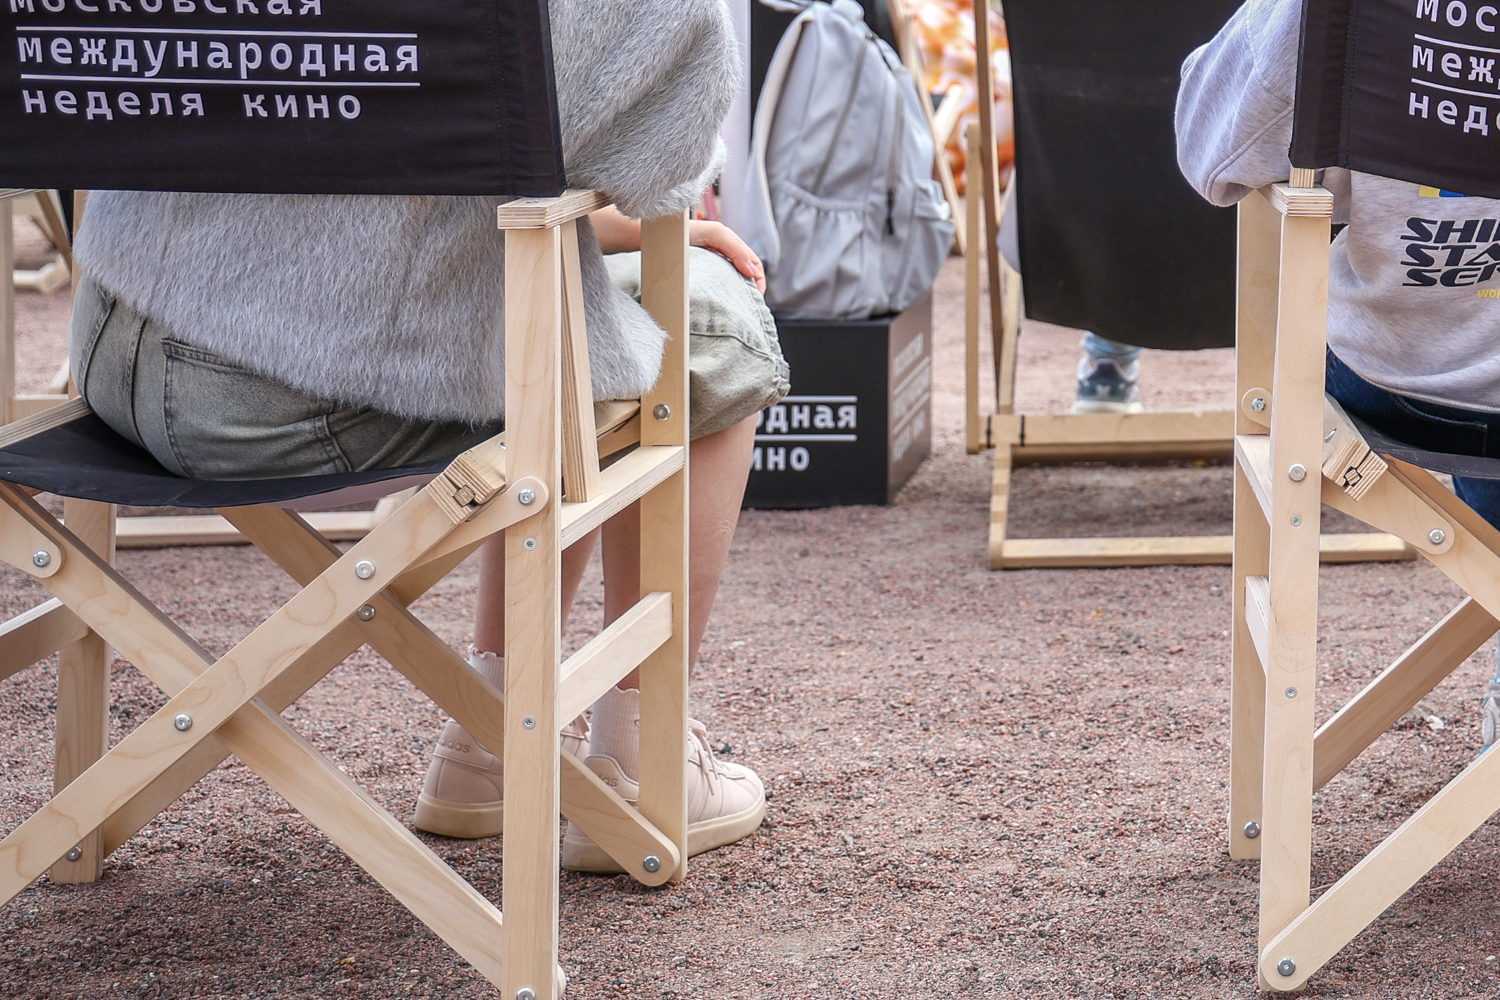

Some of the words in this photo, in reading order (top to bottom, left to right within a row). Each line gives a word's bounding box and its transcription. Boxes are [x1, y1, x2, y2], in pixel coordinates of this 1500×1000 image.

[17, 37, 419, 80] международная
[22, 89, 205, 121] неделя
[243, 93, 362, 120] кино
